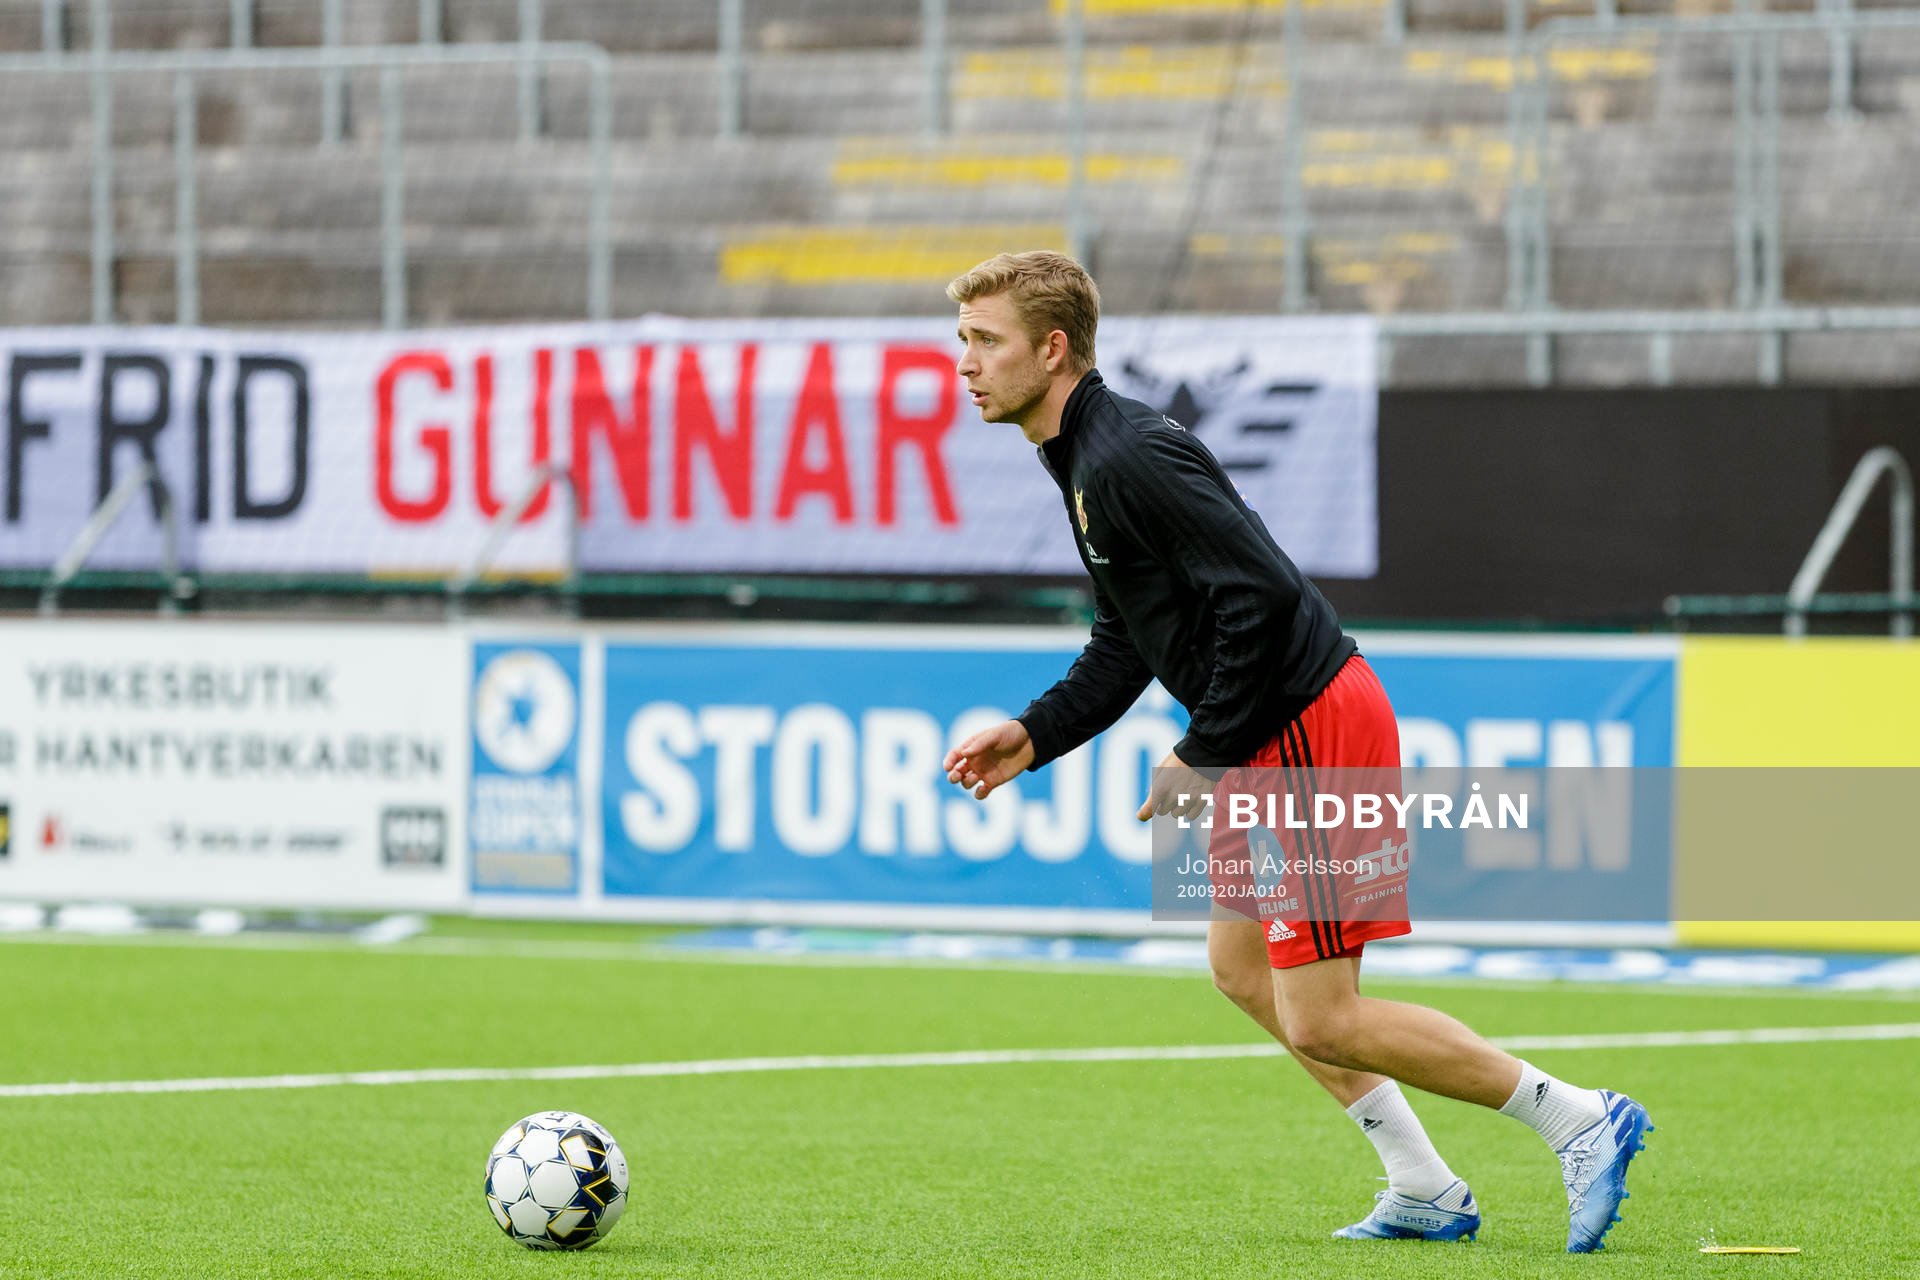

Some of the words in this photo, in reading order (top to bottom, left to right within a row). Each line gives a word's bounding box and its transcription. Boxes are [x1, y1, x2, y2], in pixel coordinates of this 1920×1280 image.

[5, 353, 313, 524] FRID
[373, 341, 960, 527] GUNNAR
[28, 664, 332, 708] YRKESBUTIK
[35, 731, 444, 778] HANTVERKAREN
[622, 683, 1635, 873] STORSJÖPEN
[1354, 885, 1404, 905] TRAINING
[1268, 929, 1297, 943] adidas
